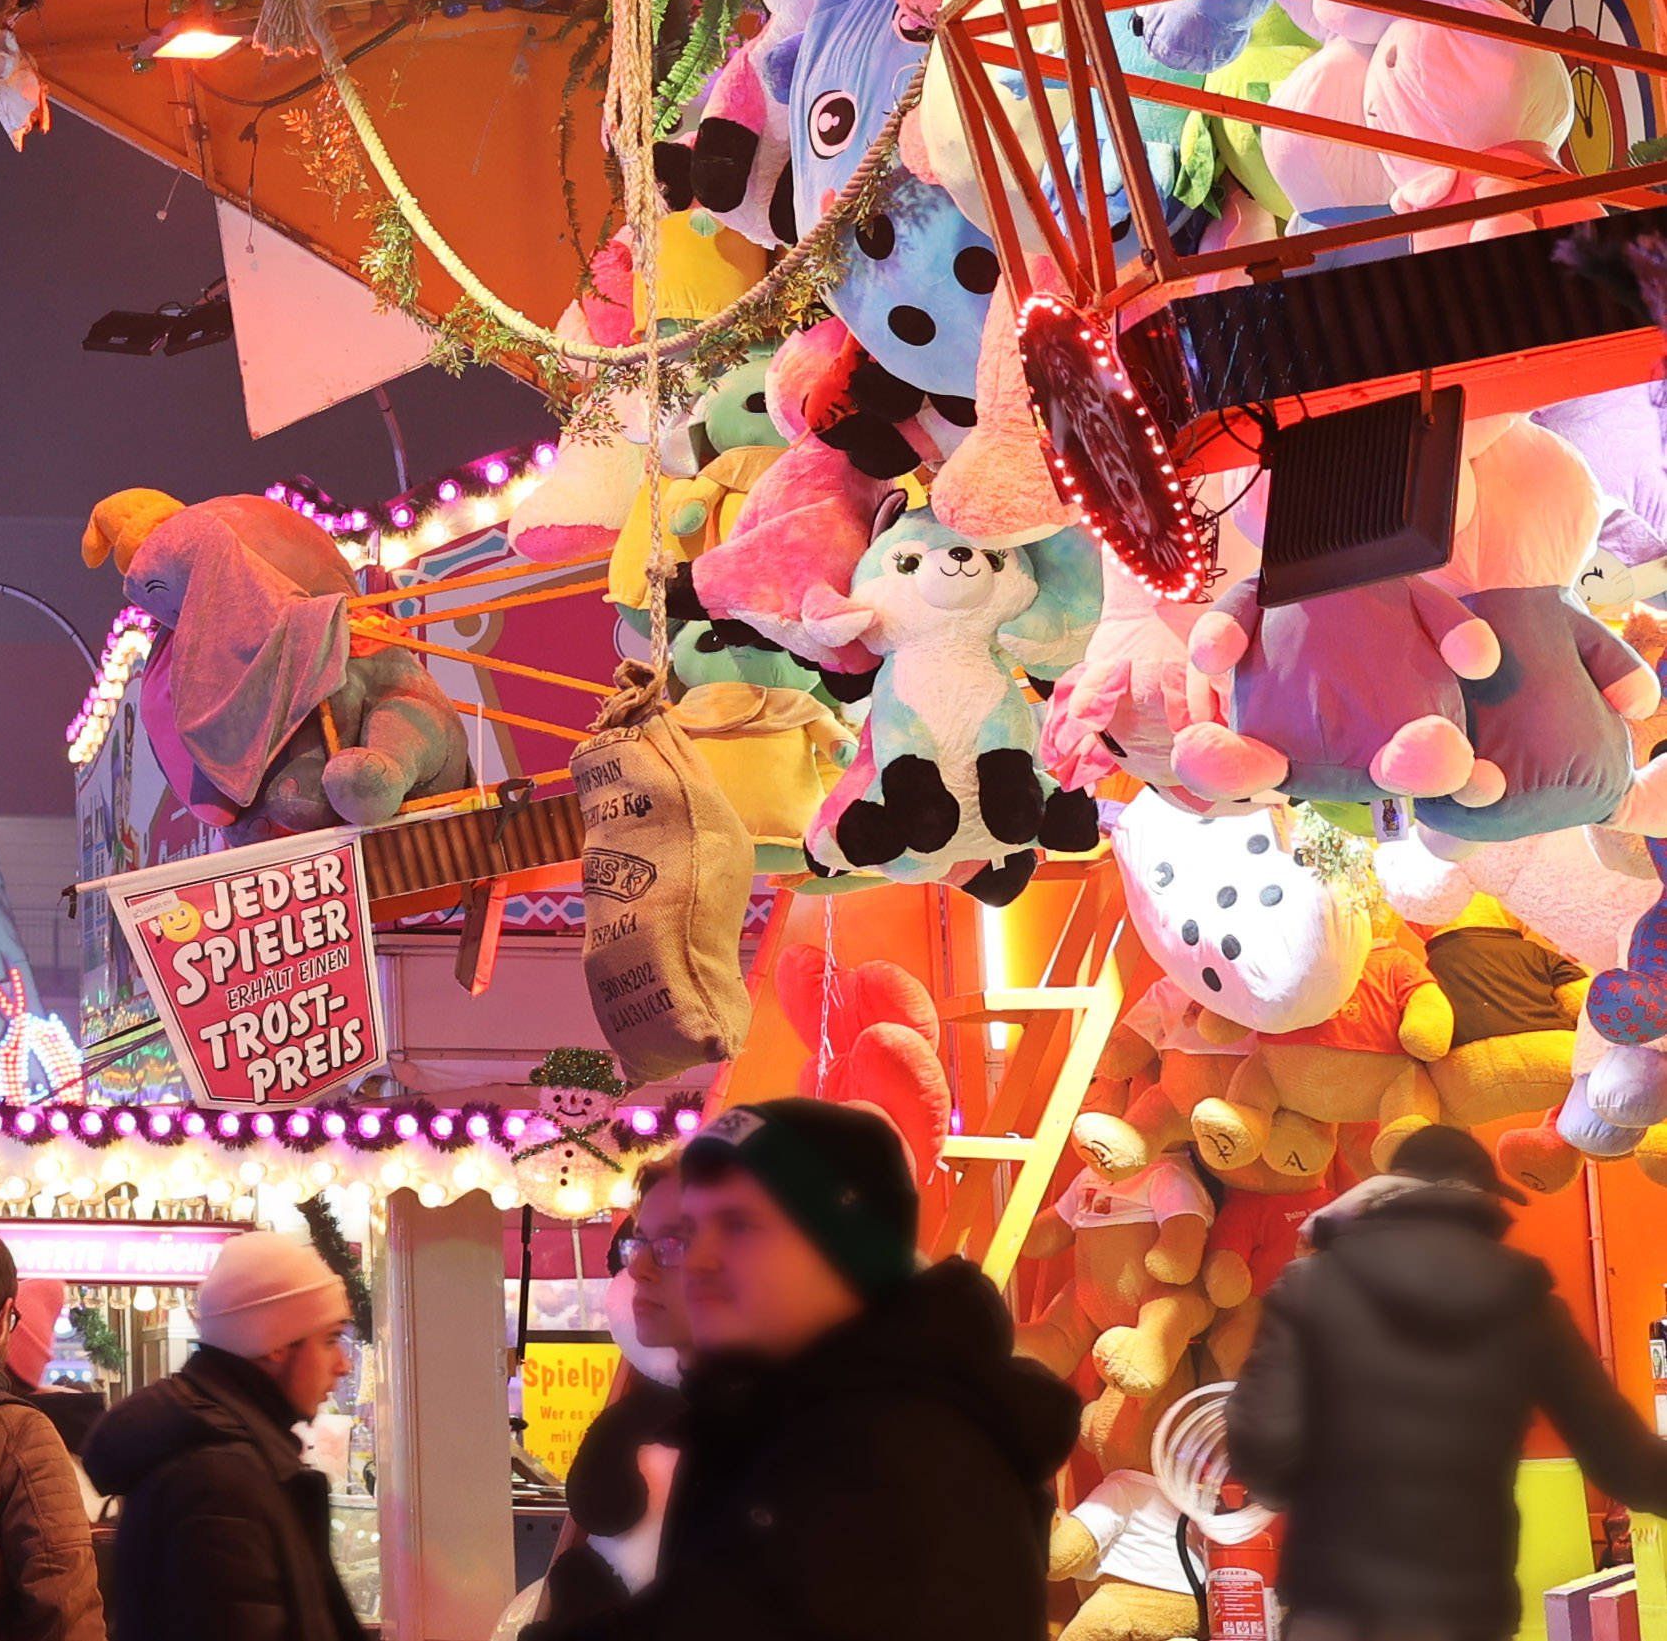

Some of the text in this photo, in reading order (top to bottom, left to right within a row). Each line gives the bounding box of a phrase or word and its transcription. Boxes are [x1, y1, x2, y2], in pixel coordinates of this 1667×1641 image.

[591, 757, 623, 788] SPAIN
[601, 798, 618, 821] 25
[622, 792, 653, 818] Kgs
[203, 853, 347, 931] JEDER
[172, 899, 351, 1006] SPIELER
[591, 912, 637, 951] ESPAÑA
[227, 946, 350, 1010] ERHÄLT EINEN
[200, 983, 347, 1070] TROST-
[247, 1017, 363, 1104] PREIS
[540, 1406, 564, 1420] Wer
[570, 1410, 583, 1420] es
